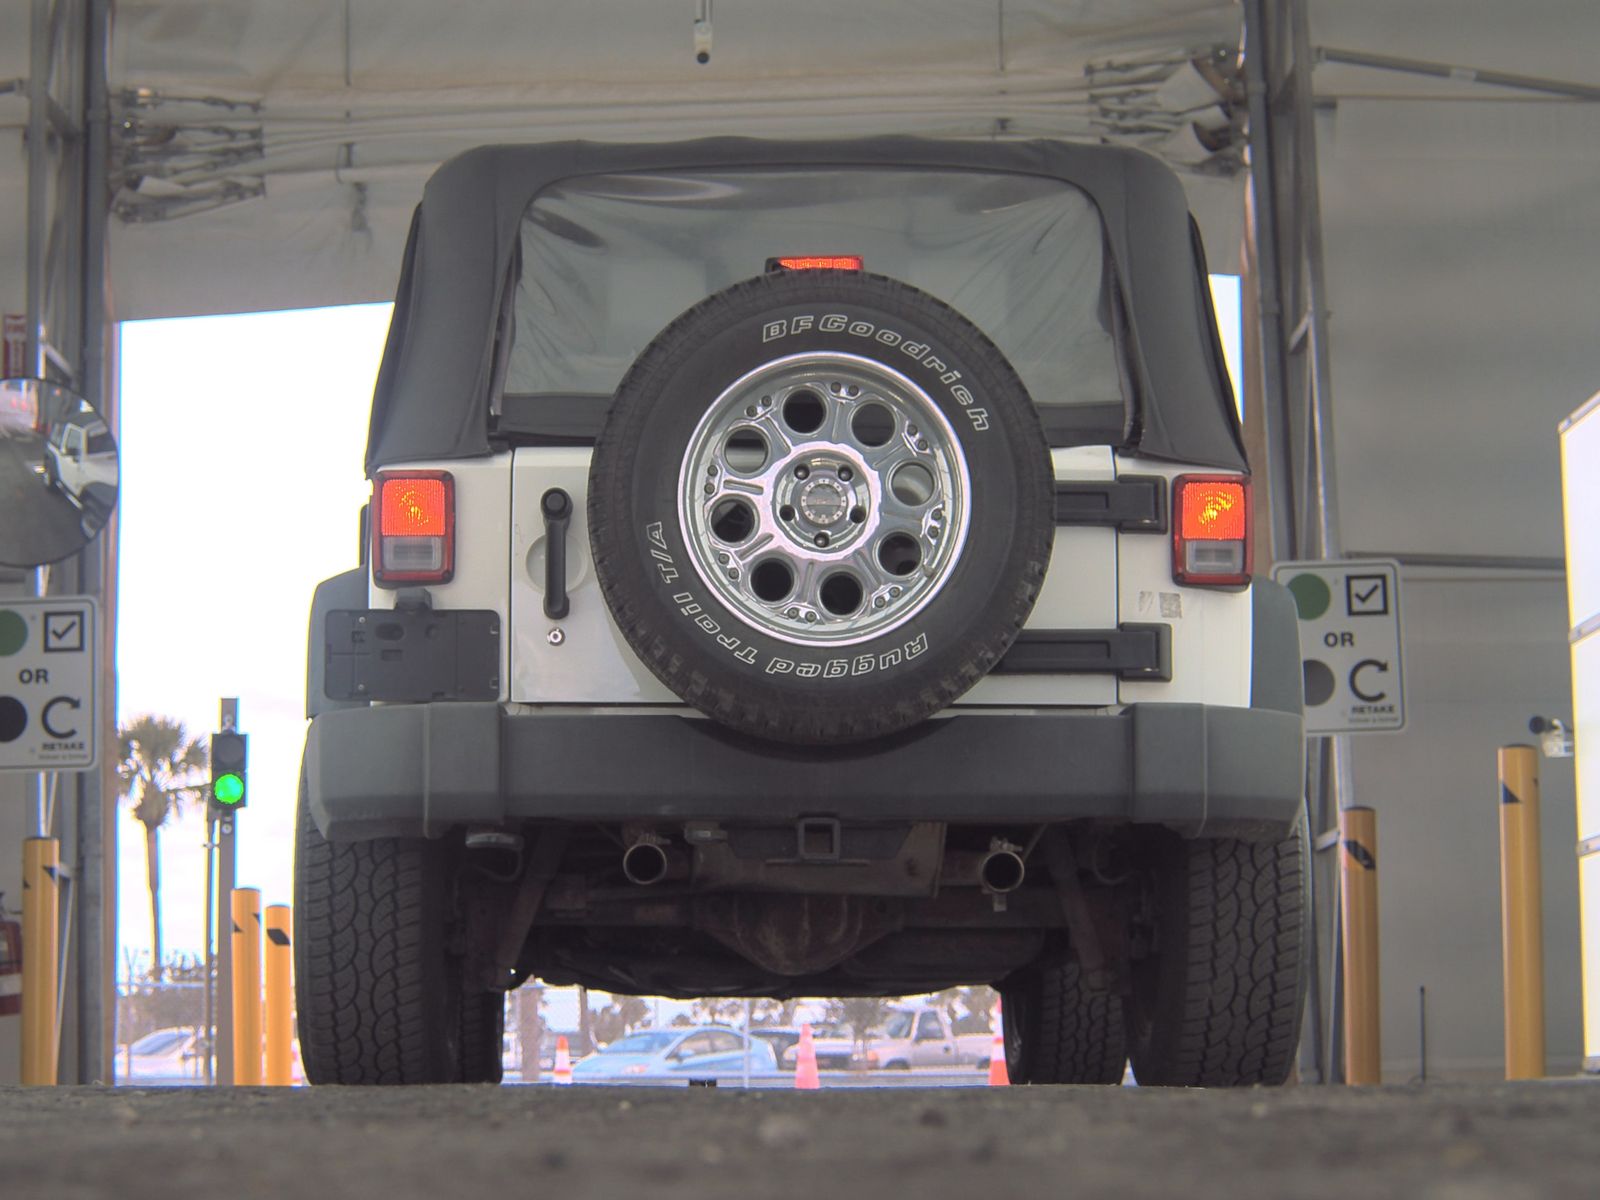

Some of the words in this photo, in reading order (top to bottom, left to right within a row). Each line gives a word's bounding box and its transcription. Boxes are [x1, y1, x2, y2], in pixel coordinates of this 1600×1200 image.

[762, 314, 990, 432] BFGoodrich
[645, 520, 679, 584] T/A
[672, 591, 759, 665] Trail
[1323, 631, 1355, 648] OR
[765, 632, 930, 679] Rugged
[18, 668, 49, 685] OR
[1351, 705, 1394, 714] RETAKE
[42, 742, 85, 751] RETAKE
